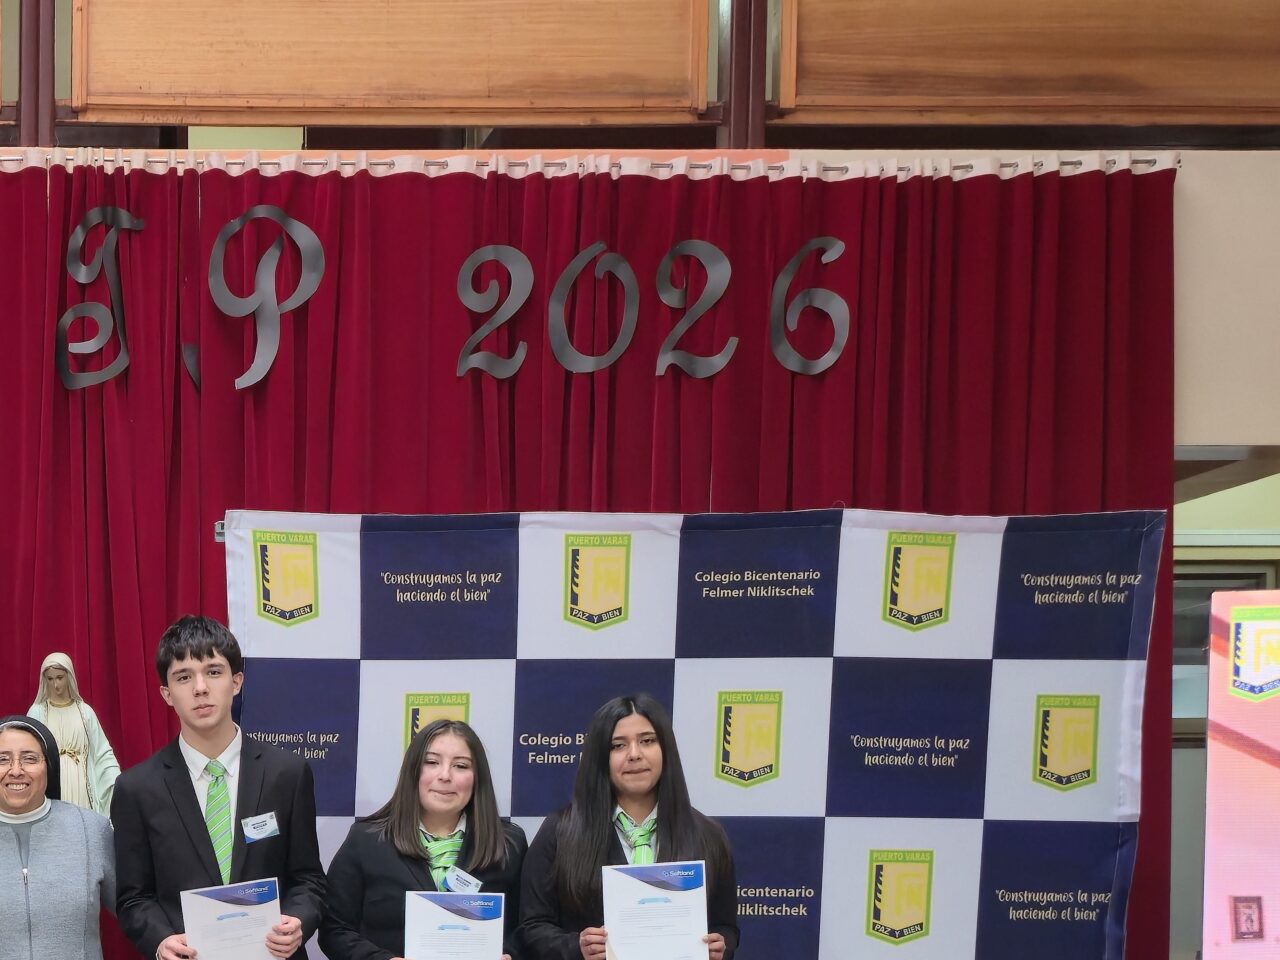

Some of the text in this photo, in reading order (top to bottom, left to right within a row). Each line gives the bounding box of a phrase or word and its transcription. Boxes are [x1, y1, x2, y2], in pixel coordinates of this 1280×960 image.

[456, 236, 851, 378] 2026
[256, 533, 315, 543] PUERTO VARAS
[568, 535, 628, 545] PUERTO VARAS
[466, 571, 477, 584] la
[481, 572, 502, 585] paz
[694, 570, 820, 585] Colegio Bicentenario
[1105, 573, 1116, 585] la
[1120, 574, 1141, 587] paz
[397, 588, 446, 602] haciendo
[450, 588, 460, 601] el
[702, 585, 814, 598] Felmer Niklitschek
[1035, 590, 1084, 604] haciendo
[1088, 590, 1098, 604] el
[265, 604, 281, 617] PAZ
[293, 605, 311, 616] BIEN
[571, 608, 588, 621] PAZ
[601, 609, 619, 620] BIEN
[307, 731, 316, 743] la
[320, 733, 339, 745] paz
[519, 734, 572, 748] Colegio
[934, 736, 945, 749] la
[949, 738, 970, 750] paz
[528, 752, 576, 763] Felmer
[865, 752, 914, 766] haciendo
[918, 752, 928, 765] el
[724, 766, 739, 777] PAZ
[753, 766, 770, 777] BIEN
[736, 886, 814, 898] icentenario
[1077, 890, 1088, 902] la
[1091, 892, 1111, 904] paz
[736, 903, 807, 916] iklitschek
[1009, 907, 1058, 919] haciendo
[1061, 907, 1071, 920] el
